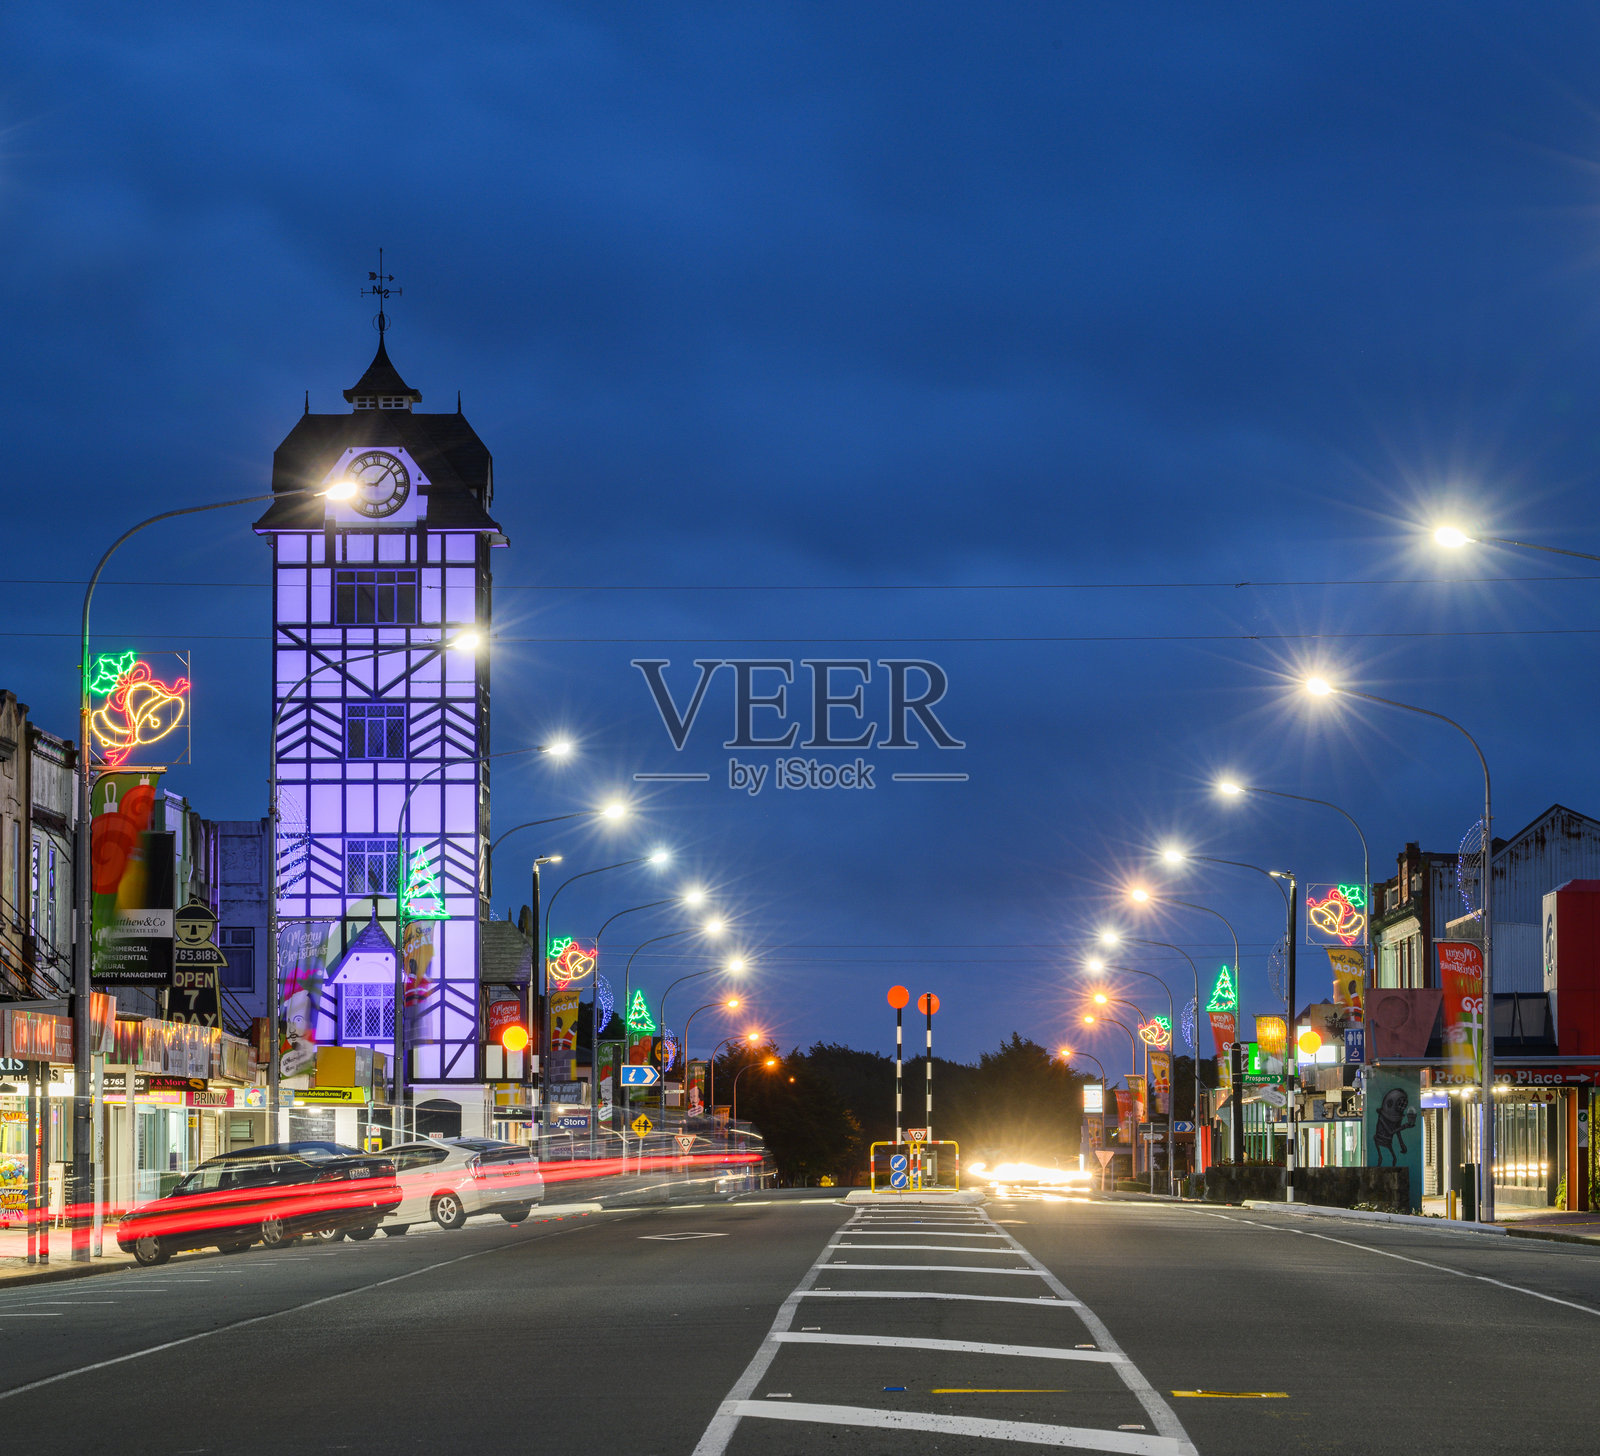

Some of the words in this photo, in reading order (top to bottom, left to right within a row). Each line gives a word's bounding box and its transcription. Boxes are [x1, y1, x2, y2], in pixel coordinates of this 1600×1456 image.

[174, 971, 214, 989] OPEN
[183, 989, 200, 1011] 7
[551, 1001, 579, 1014] LOCAL
[13, 1015, 53, 1056] CENTRAL
[110, 1078, 125, 1086] 765
[1515, 1070, 1563, 1084] Place
[193, 1092, 227, 1105] PRINTZ
[563, 1118, 586, 1126] Store
